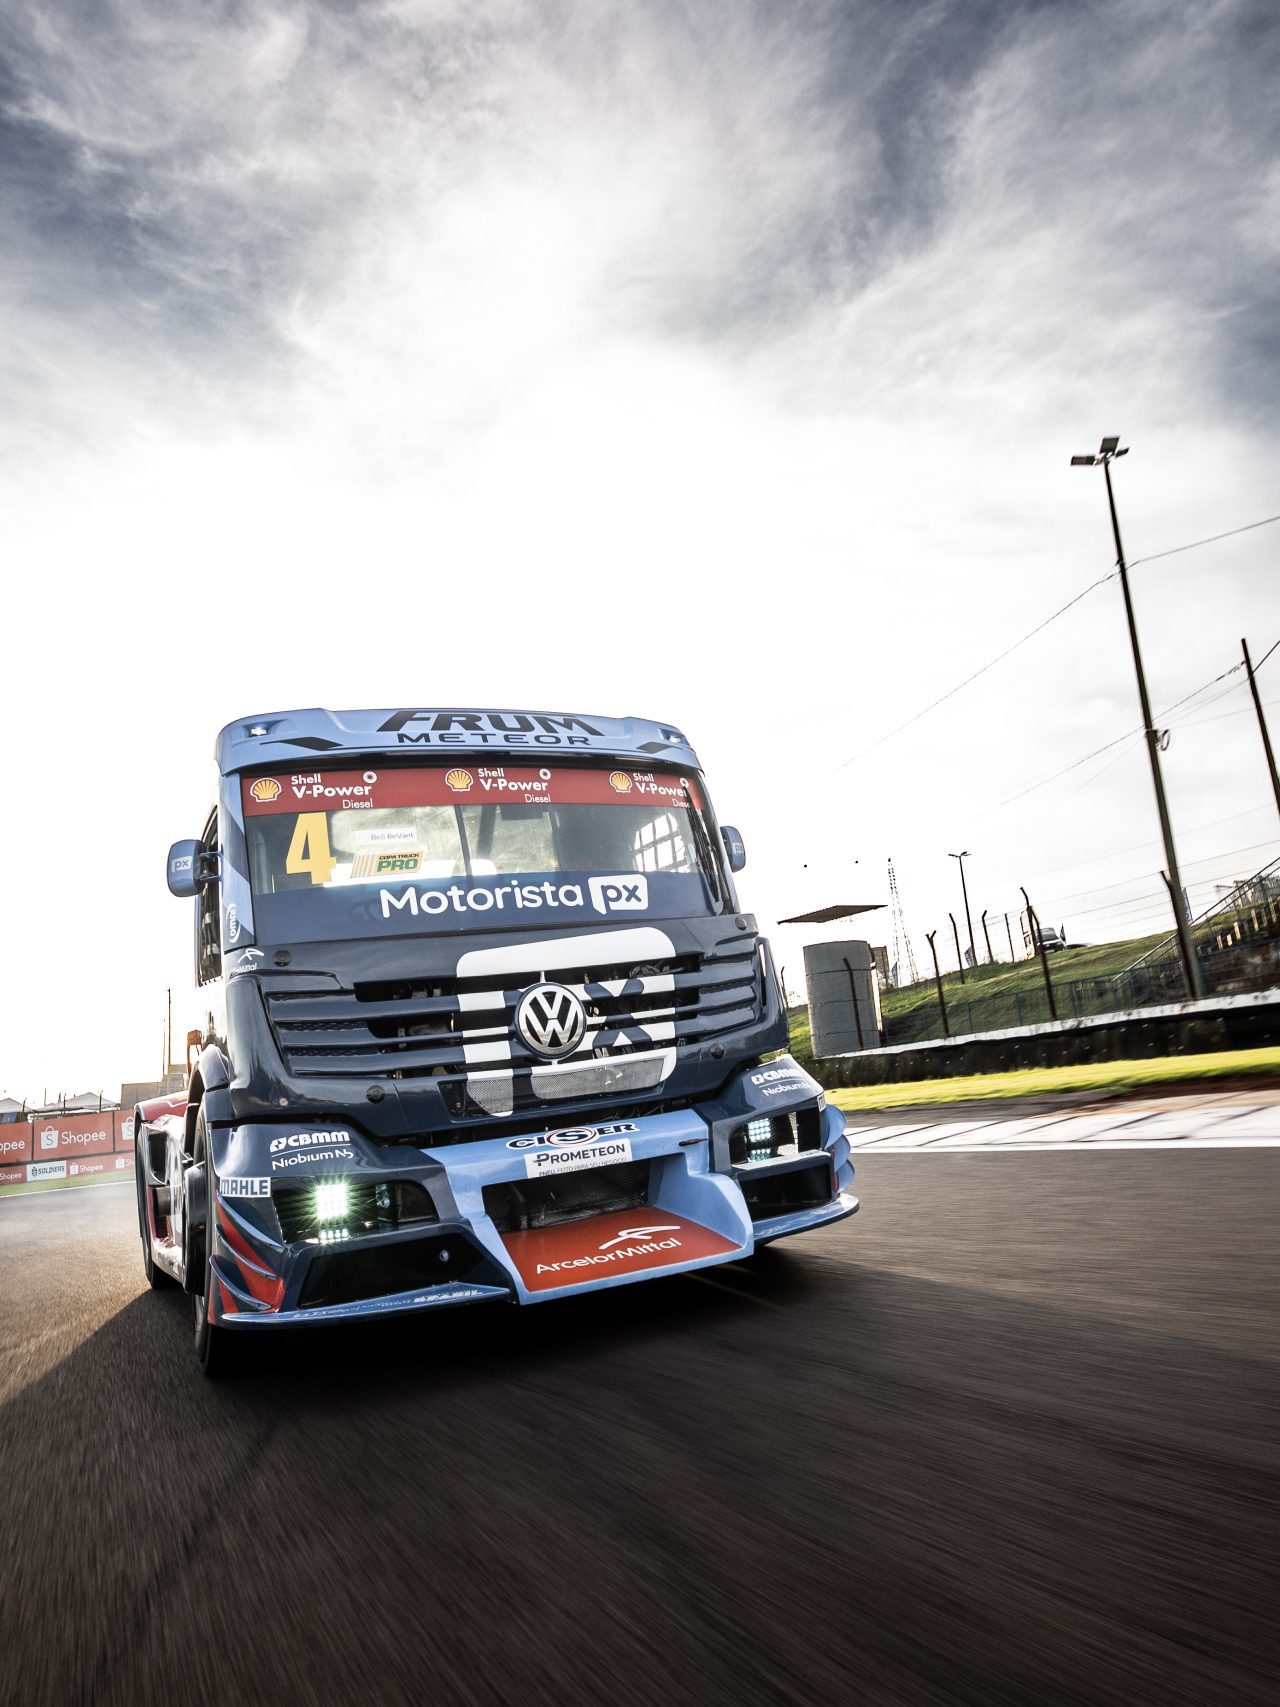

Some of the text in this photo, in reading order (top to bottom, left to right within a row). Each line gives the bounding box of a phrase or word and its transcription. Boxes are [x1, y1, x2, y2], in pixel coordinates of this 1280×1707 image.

[376, 710, 605, 737] FRUM
[396, 733, 592, 745] METEOR
[291, 773, 321, 785] Shell
[478, 768, 504, 777] Shell
[633, 773, 654, 782] Shell
[480, 779, 548, 790] V-Power
[292, 785, 372, 799] V-Power
[524, 794, 551, 803] Diesel
[342, 799, 373, 809] Diesel
[286, 812, 336, 884] 4
[174, 858, 190, 871] px
[377, 859, 418, 872] PRO
[380, 880, 645, 918] Motorista px
[61, 1131, 106, 1146] Shopee
[507, 1123, 638, 1149] CISER
[272, 1151, 333, 1170] Niobium
[533, 1144, 625, 1166] PROMETEON
[38, 1165, 64, 1174] SOLDIERS
[80, 1164, 103, 1173] Shopee
[0, 1172, 22, 1181] Shopee
[221, 1178, 269, 1195] MAHLE
[536, 1238, 682, 1274] ArcelorMittal
